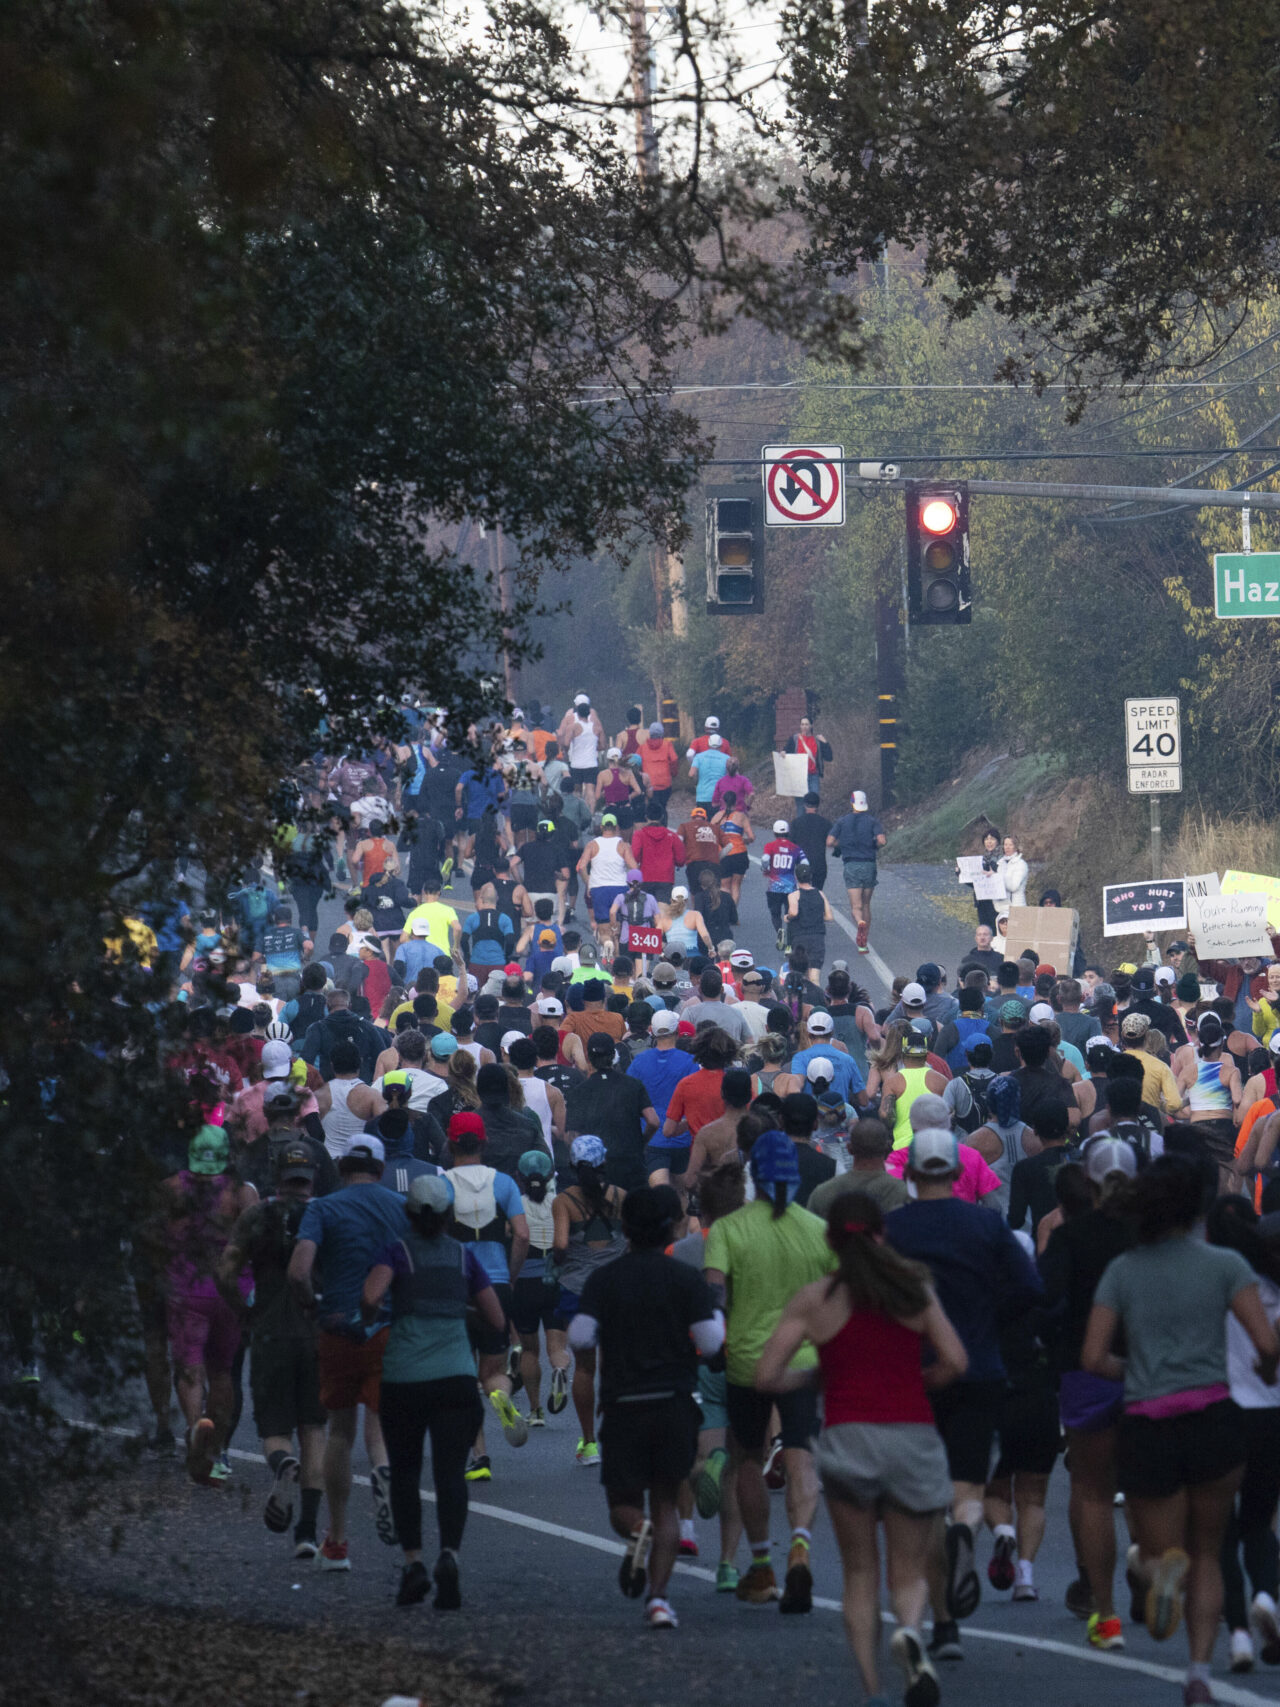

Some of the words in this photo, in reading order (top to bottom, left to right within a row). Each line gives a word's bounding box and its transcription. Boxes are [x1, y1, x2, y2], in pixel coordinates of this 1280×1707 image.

[1131, 706, 1175, 717] SPEED
[1137, 720, 1170, 731] LIMIT
[1132, 733, 1176, 757] 40
[1141, 770, 1168, 779] RADAR
[1135, 780, 1175, 789] ENFORCED
[773, 854, 793, 869] 007
[1112, 891, 1135, 905] WHO
[1148, 888, 1176, 899] HURT
[1131, 903, 1153, 912] YOU
[1158, 900, 1166, 912] ?
[1230, 899, 1264, 917] Running
[1202, 922, 1226, 934] Better
[631, 932, 659, 948] 3:40
